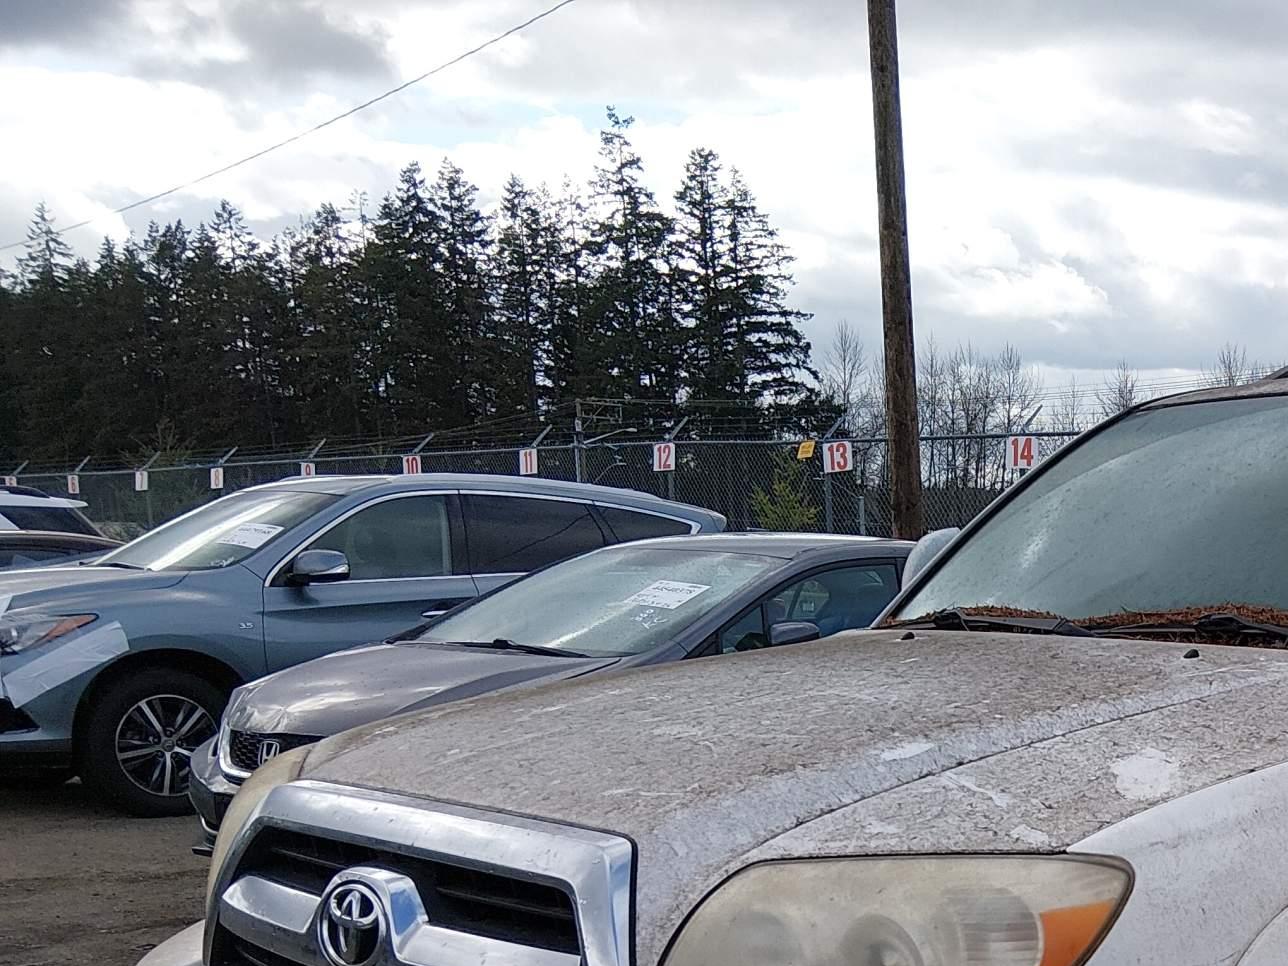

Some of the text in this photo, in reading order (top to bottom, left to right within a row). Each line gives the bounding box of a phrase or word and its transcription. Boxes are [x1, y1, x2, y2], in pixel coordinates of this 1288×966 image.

[523, 450, 533, 474] 11
[657, 444, 671, 469] 12
[827, 442, 848, 471] 13
[1011, 437, 1034, 467] 14
[405, 456, 418, 474] 10
